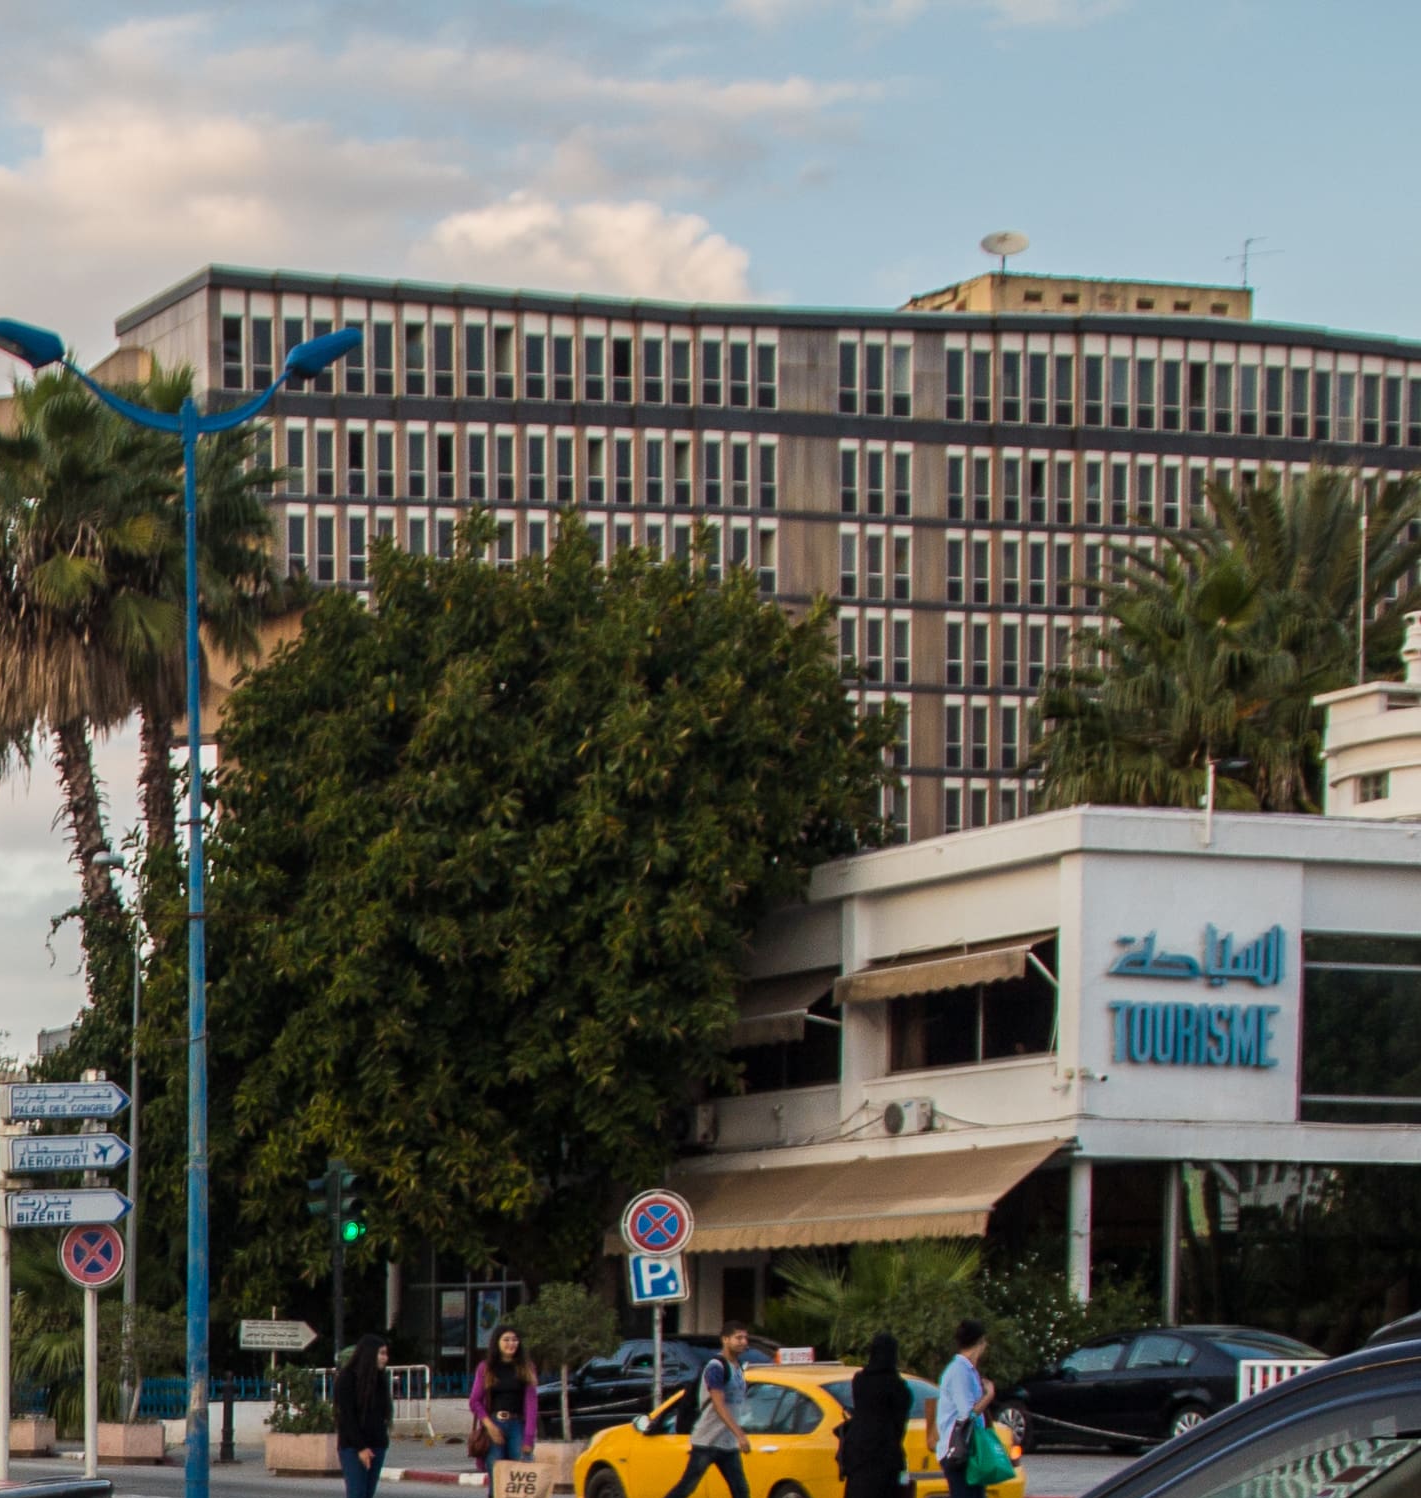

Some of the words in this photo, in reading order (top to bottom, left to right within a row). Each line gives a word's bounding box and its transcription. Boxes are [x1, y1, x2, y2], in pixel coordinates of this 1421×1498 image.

[1108, 922, 1285, 987] السياحة
[1109, 1000, 1281, 1069] TOURISME
[13, 1104, 45, 1114] PALAIS
[49, 1104, 67, 1113] DES
[19, 1154, 89, 1168] AEROPORT
[17, 1193, 72, 1212] بنزرت
[17, 1209, 72, 1222] BIZERTE
[640, 1258, 670, 1295] P
[509, 1471, 537, 1482] we
[504, 1482, 535, 1495] are
